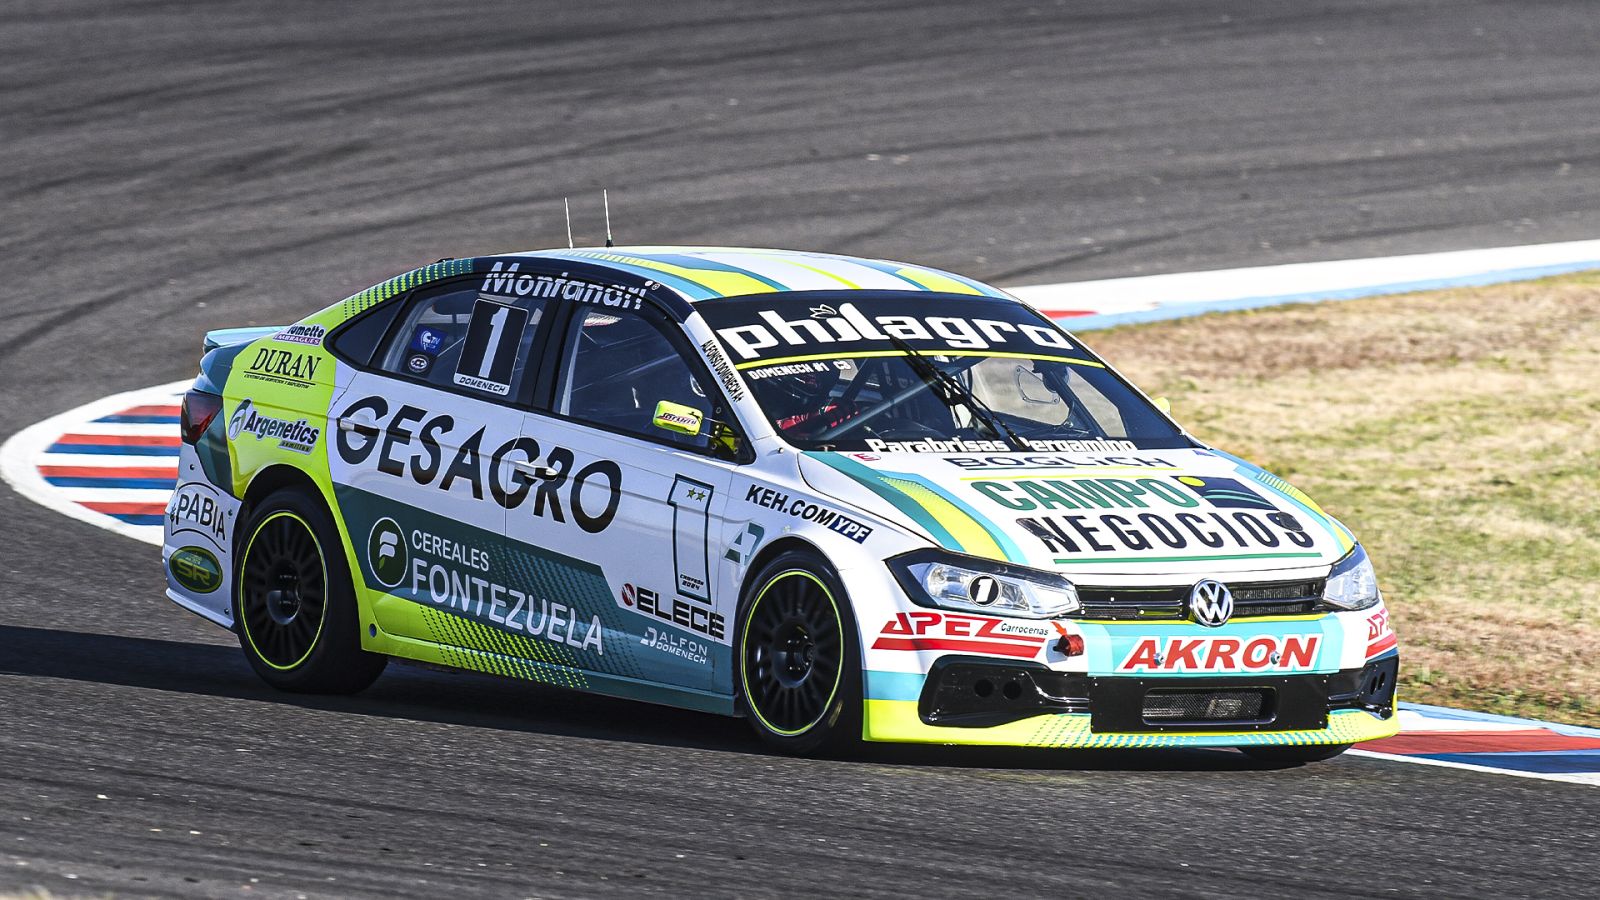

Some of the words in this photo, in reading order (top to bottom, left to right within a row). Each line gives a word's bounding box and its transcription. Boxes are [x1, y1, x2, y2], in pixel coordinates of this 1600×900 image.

[488, 307, 510, 379] 1
[716, 302, 1074, 360] philagro
[249, 347, 322, 381] DURAN
[746, 363, 814, 380] DOMENECH
[459, 376, 506, 394] DOMENECH
[243, 410, 320, 445] Argenetics
[864, 435, 1009, 453] Parabrisas
[336, 395, 623, 534] GESAGRO
[970, 477, 1201, 511] CAMPO
[175, 492, 226, 541] PABIA
[745, 484, 836, 526] KEH.COM
[834, 517, 871, 541] YPF
[411, 529, 490, 571] CEREALES
[175, 558, 211, 586] SR
[411, 558, 604, 656] FONTEZUELA
[975, 578, 994, 603] 1
[636, 586, 725, 641] ELECE
[880, 612, 1046, 643] APEZ
[656, 642, 707, 665] DOMENECH
[658, 631, 708, 657] ALFON
[1122, 636, 1318, 670] AKRON
